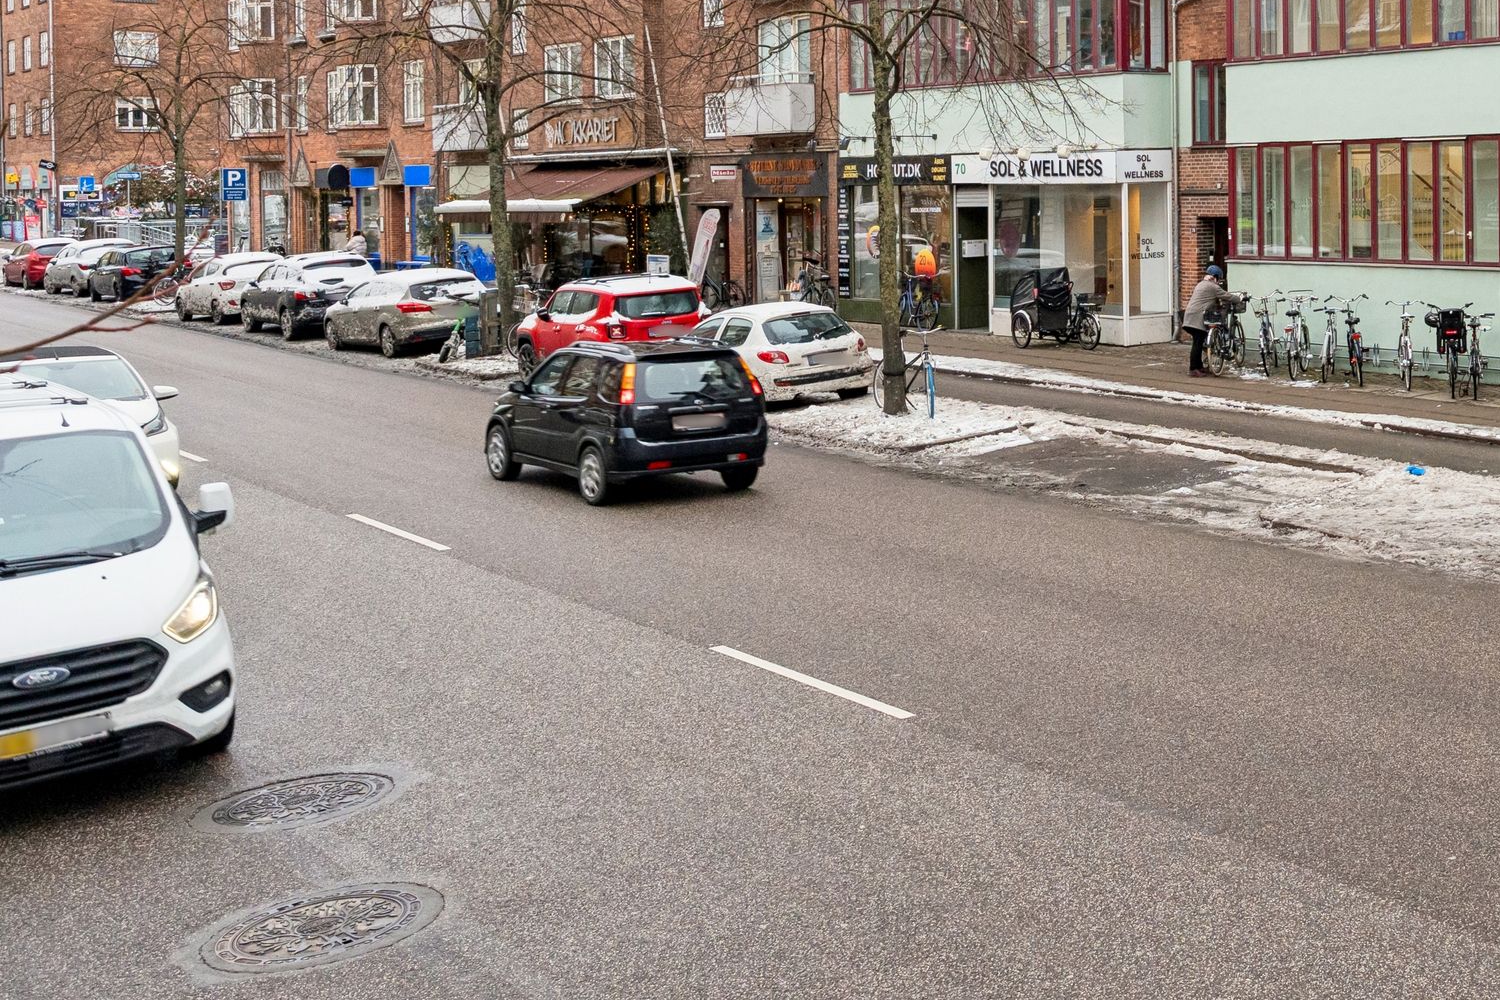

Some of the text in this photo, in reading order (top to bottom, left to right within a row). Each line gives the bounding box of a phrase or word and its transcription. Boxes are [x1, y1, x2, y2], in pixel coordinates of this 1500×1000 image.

[1136, 154, 1151, 162] SOL
[954, 158, 1103, 178] 70 SOL & WELLNESS
[228, 171, 241, 187] P
[1124, 170, 1164, 179] WELLNESS
[1131, 251, 1165, 260] WELLNESS
